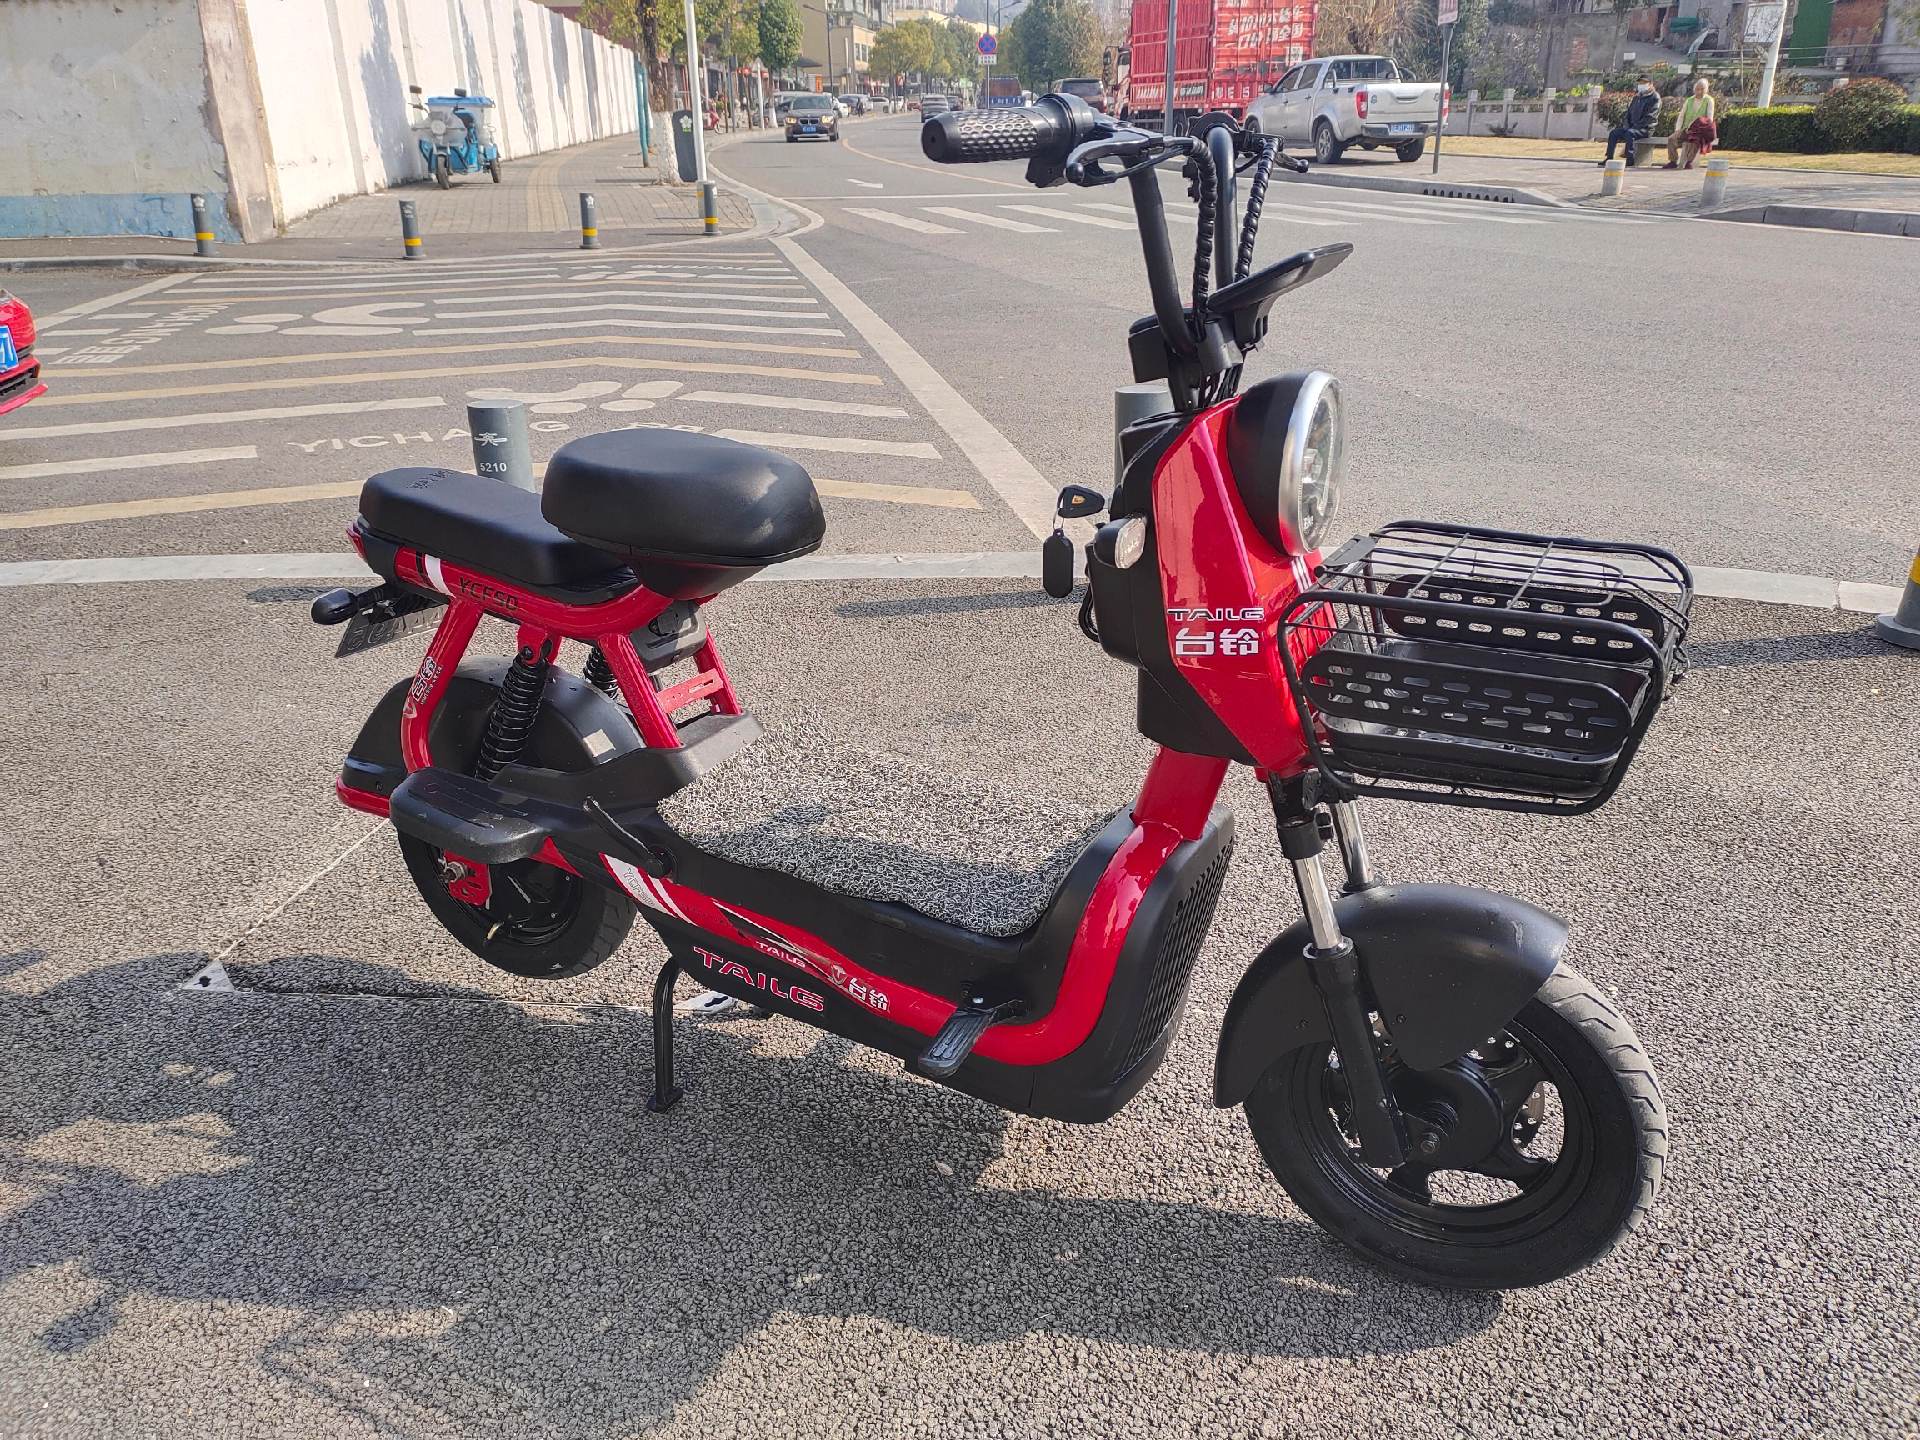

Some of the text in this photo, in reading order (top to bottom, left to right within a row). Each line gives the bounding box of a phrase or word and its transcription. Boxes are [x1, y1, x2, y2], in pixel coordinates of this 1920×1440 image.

[480, 462, 507, 474] 5210
[1166, 607, 1265, 622] TAILG
[1175, 627, 1260, 656] 台铃
[755, 941, 807, 969] TAILG
[692, 944, 825, 1012] TAILG
[848, 977, 890, 1012] 台铃
